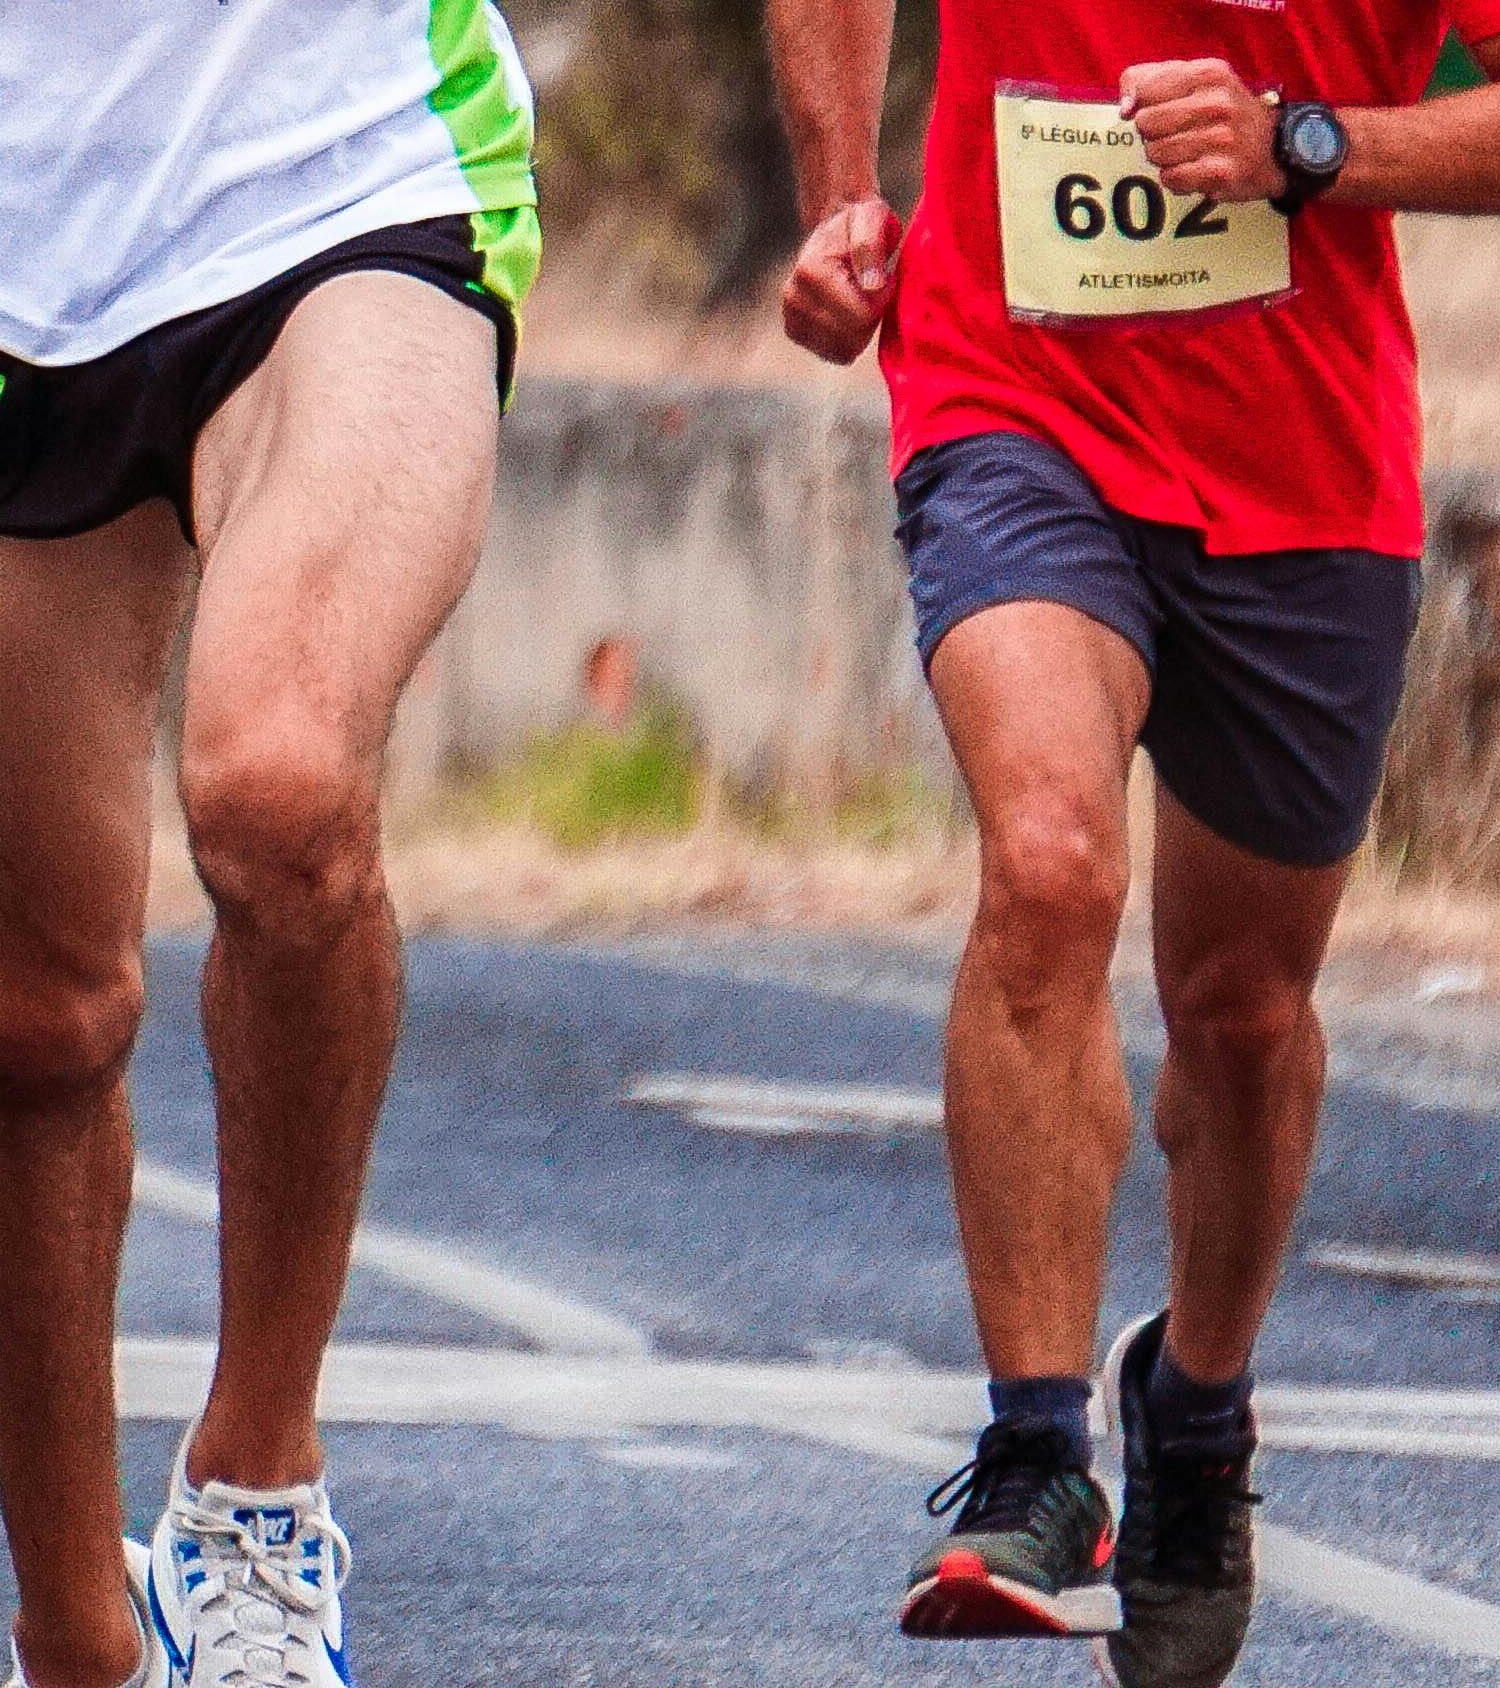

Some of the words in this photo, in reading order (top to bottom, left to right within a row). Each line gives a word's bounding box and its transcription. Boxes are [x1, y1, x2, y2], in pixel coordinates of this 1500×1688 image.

[1040, 124, 1102, 146] LÉGUA
[1107, 130, 1135, 147] DO
[1079, 269, 1212, 290] ATLETISMOITA
